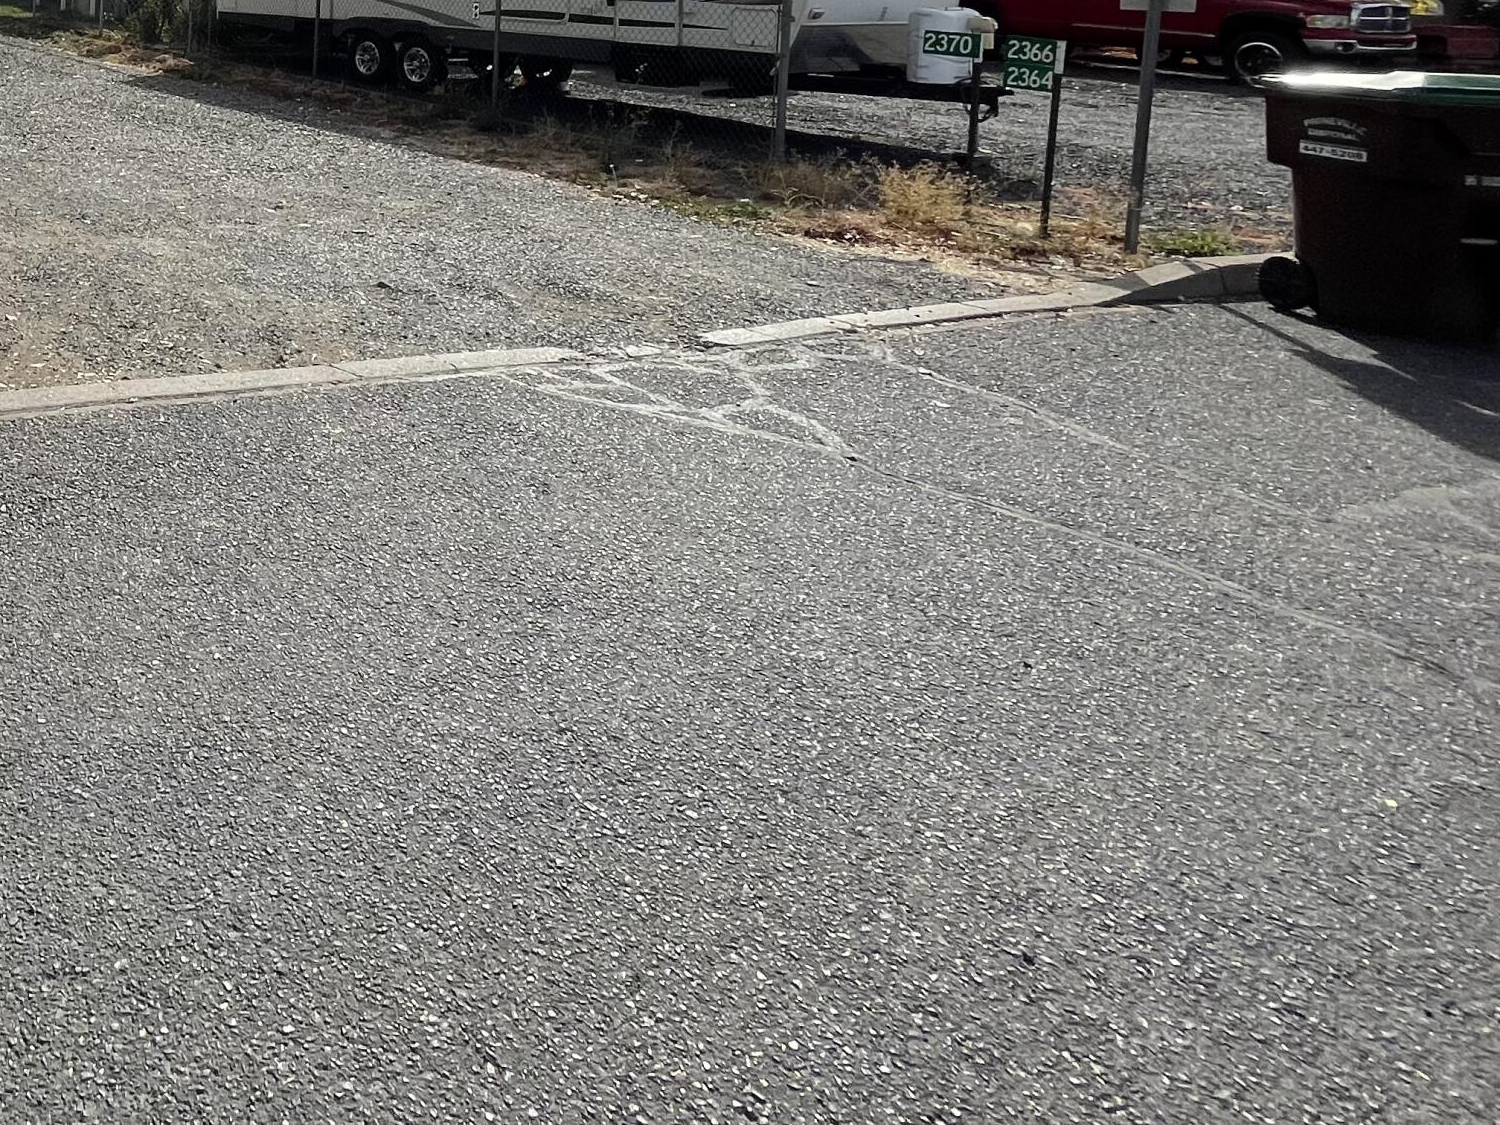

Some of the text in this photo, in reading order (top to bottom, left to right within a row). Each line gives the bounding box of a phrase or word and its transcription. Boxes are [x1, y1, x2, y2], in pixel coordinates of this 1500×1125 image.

[924, 33, 972, 54] 2370
[1007, 40, 1054, 63] 2366
[1006, 67, 1053, 89] 2364
